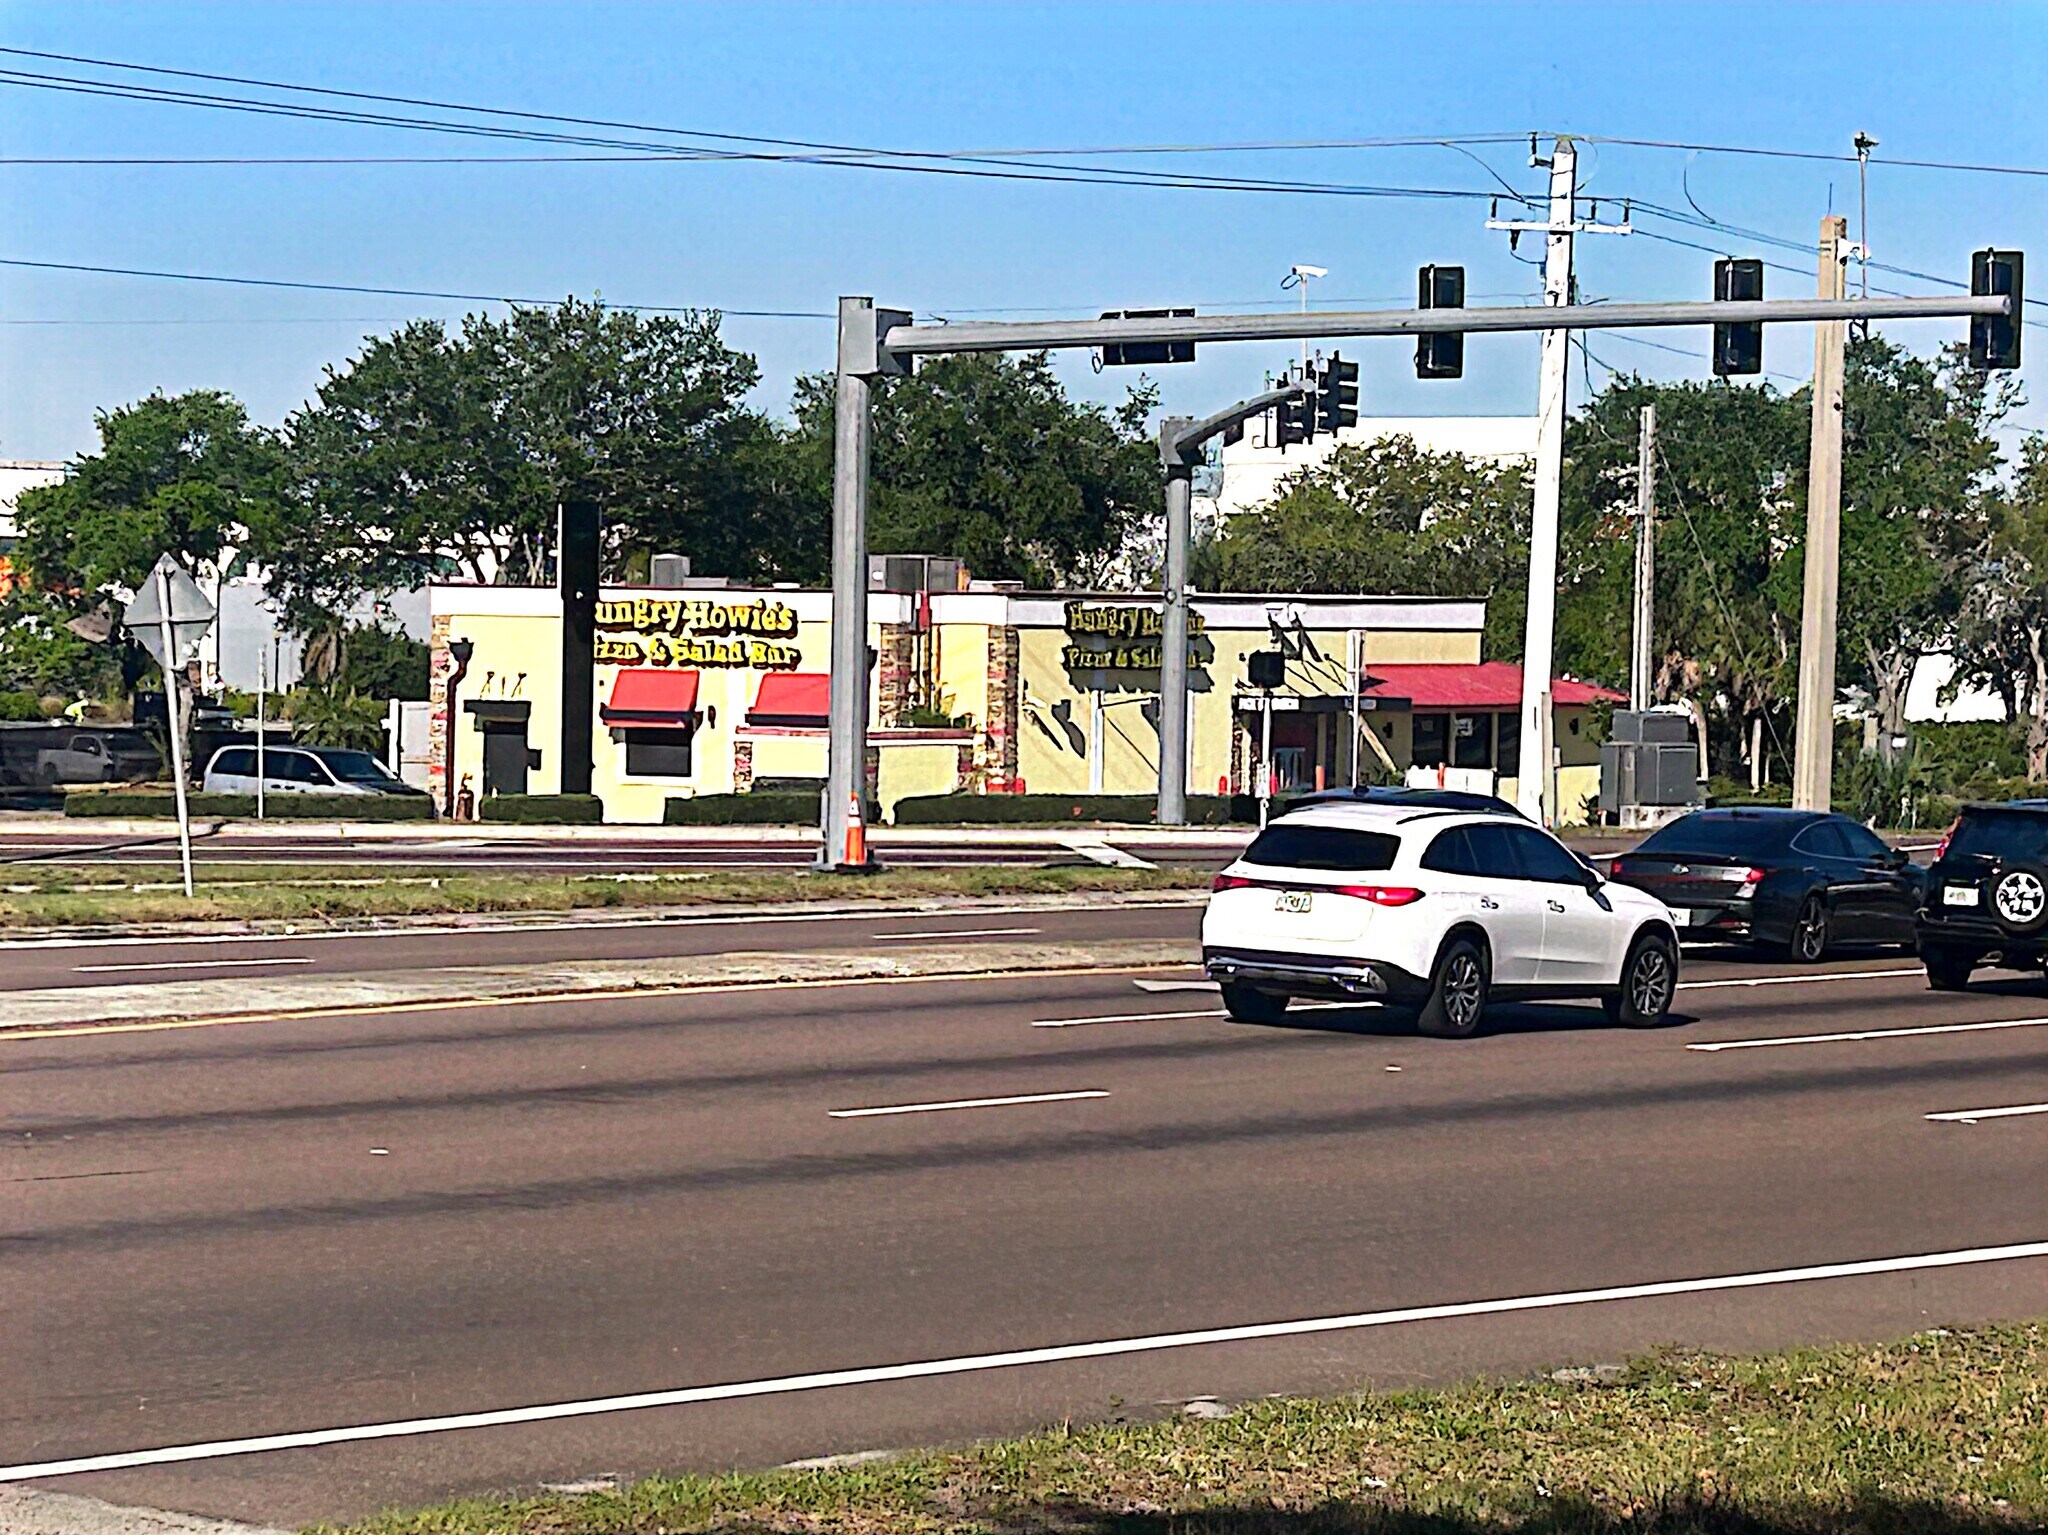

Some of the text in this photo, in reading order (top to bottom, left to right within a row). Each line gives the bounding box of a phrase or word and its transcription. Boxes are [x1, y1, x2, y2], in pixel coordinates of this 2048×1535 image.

[594, 598, 795, 633] ungry Howie's
[648, 639, 667, 662] &
[671, 637, 746, 664] Salad
[750, 640, 800, 665] Bar
